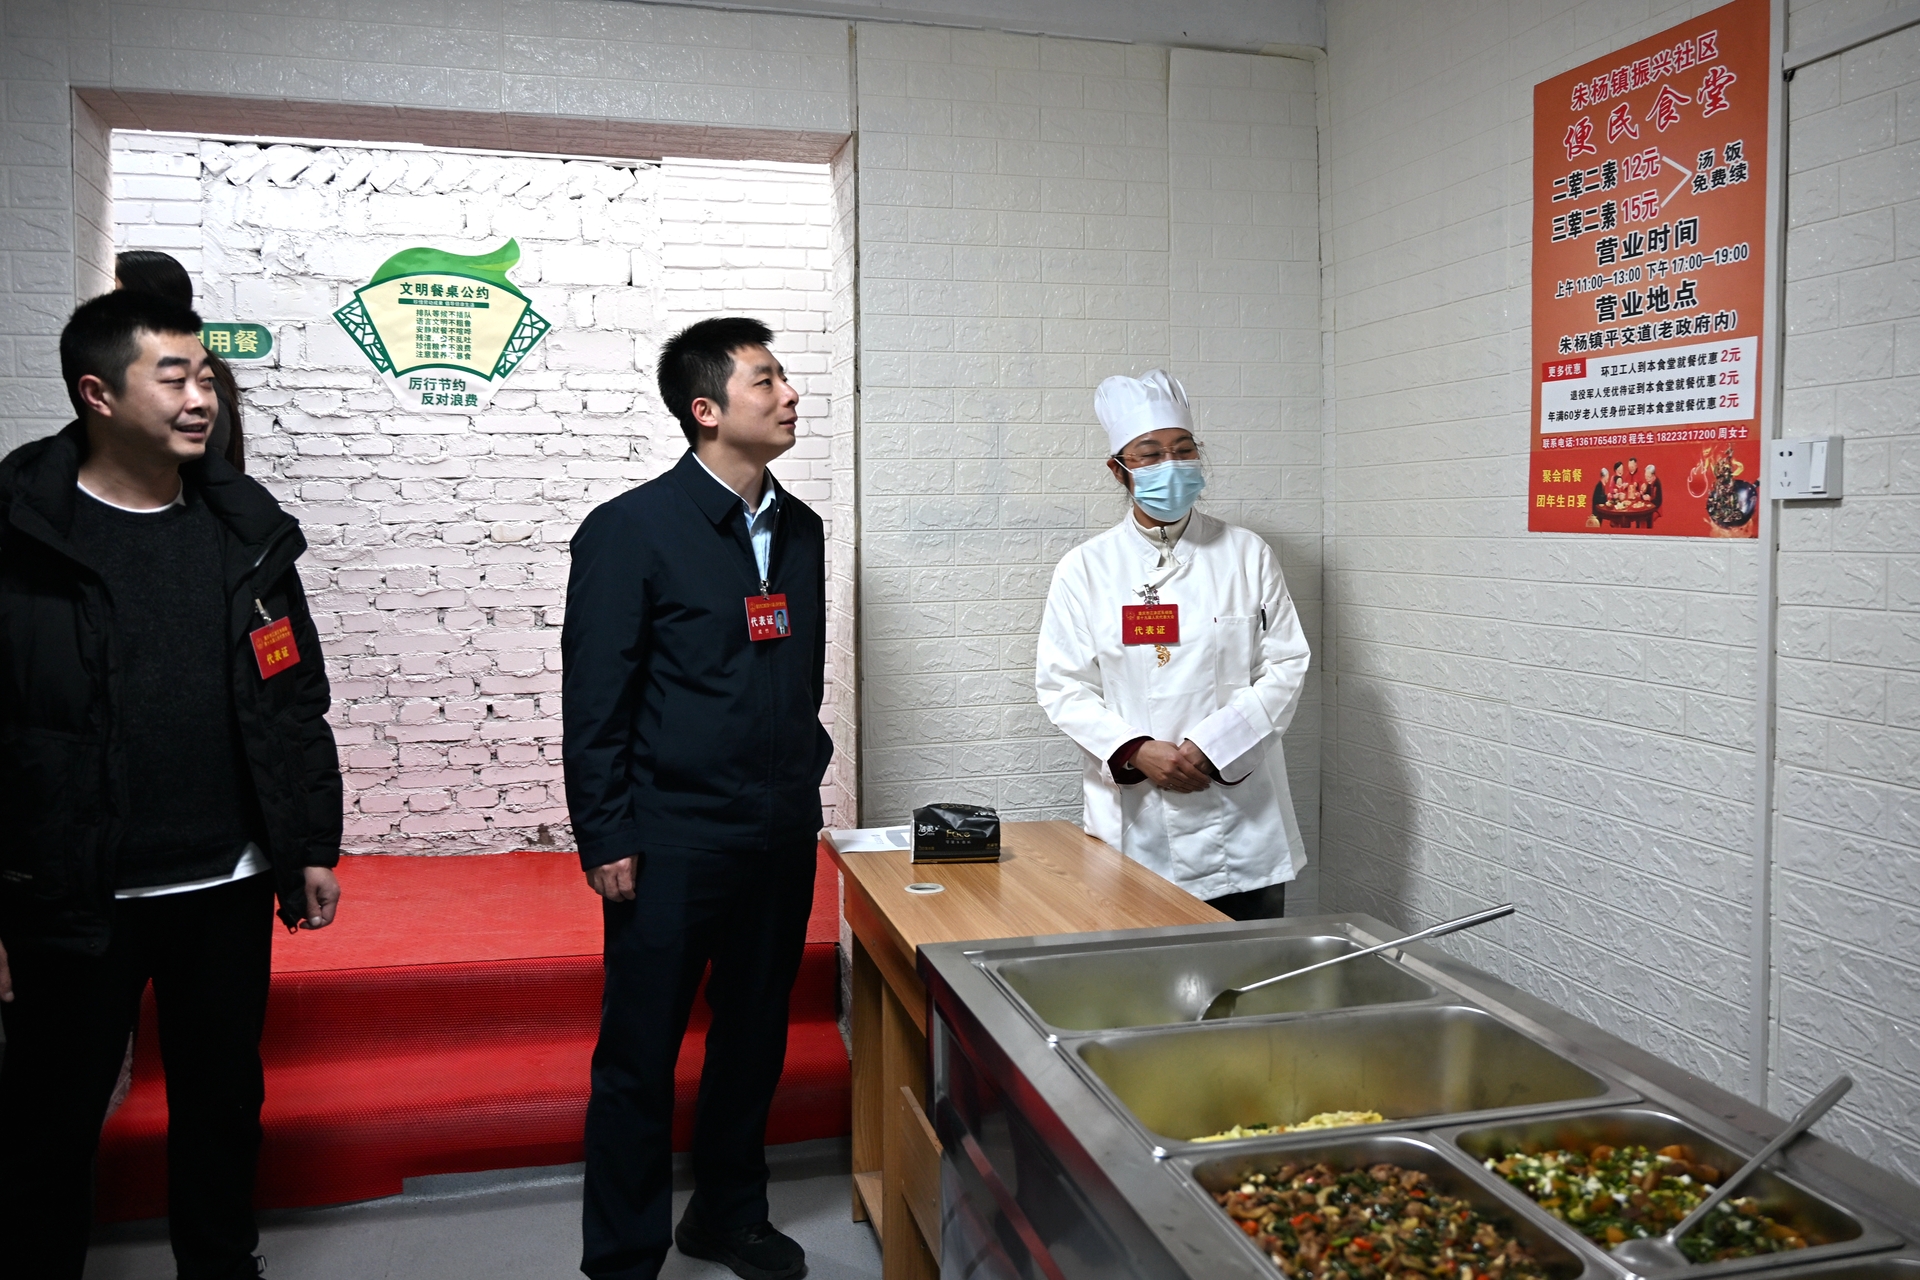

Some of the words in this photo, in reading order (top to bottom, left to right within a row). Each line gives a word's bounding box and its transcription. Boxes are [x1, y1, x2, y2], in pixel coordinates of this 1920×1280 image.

[1571, 30, 1718, 110] 朱杨镇振兴社区
[1563, 66, 1736, 160] 便民食堂
[1692, 163, 1748, 194] 免费续
[1595, 217, 1699, 266] 营业时间
[400, 282, 490, 300] 文明餐桌公约
[1595, 280, 1699, 323] 营业地点
[197, 329, 259, 353] 用餐
[1548, 363, 1582, 378] 更多优惠
[408, 377, 466, 392] 厉行节约
[421, 392, 478, 407] 反对浪费
[1718, 427, 1748, 440] 周女士
[1542, 468, 1582, 483] 聚会简餐
[1536, 494, 1587, 508] 团年生日宴
[750, 615, 774, 627] 代表证
[1134, 625, 1166, 635] 代表证
[266, 646, 290, 666] 代表证
